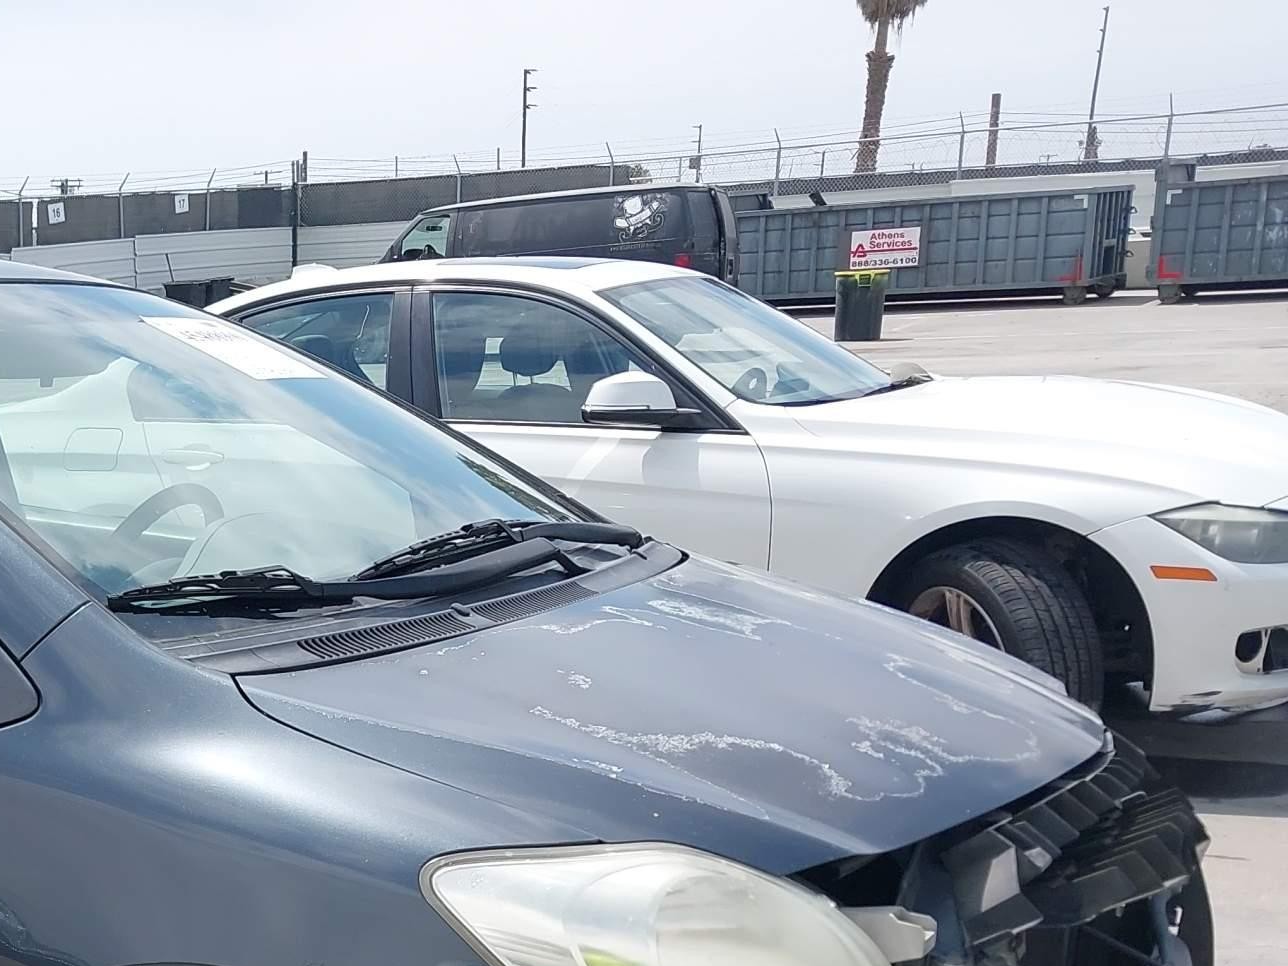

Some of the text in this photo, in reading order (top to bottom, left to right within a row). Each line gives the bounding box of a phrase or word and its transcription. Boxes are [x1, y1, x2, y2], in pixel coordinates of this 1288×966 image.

[52, 208, 61, 218] 16
[870, 232, 905, 240] Athens
[869, 239, 913, 249] Services
